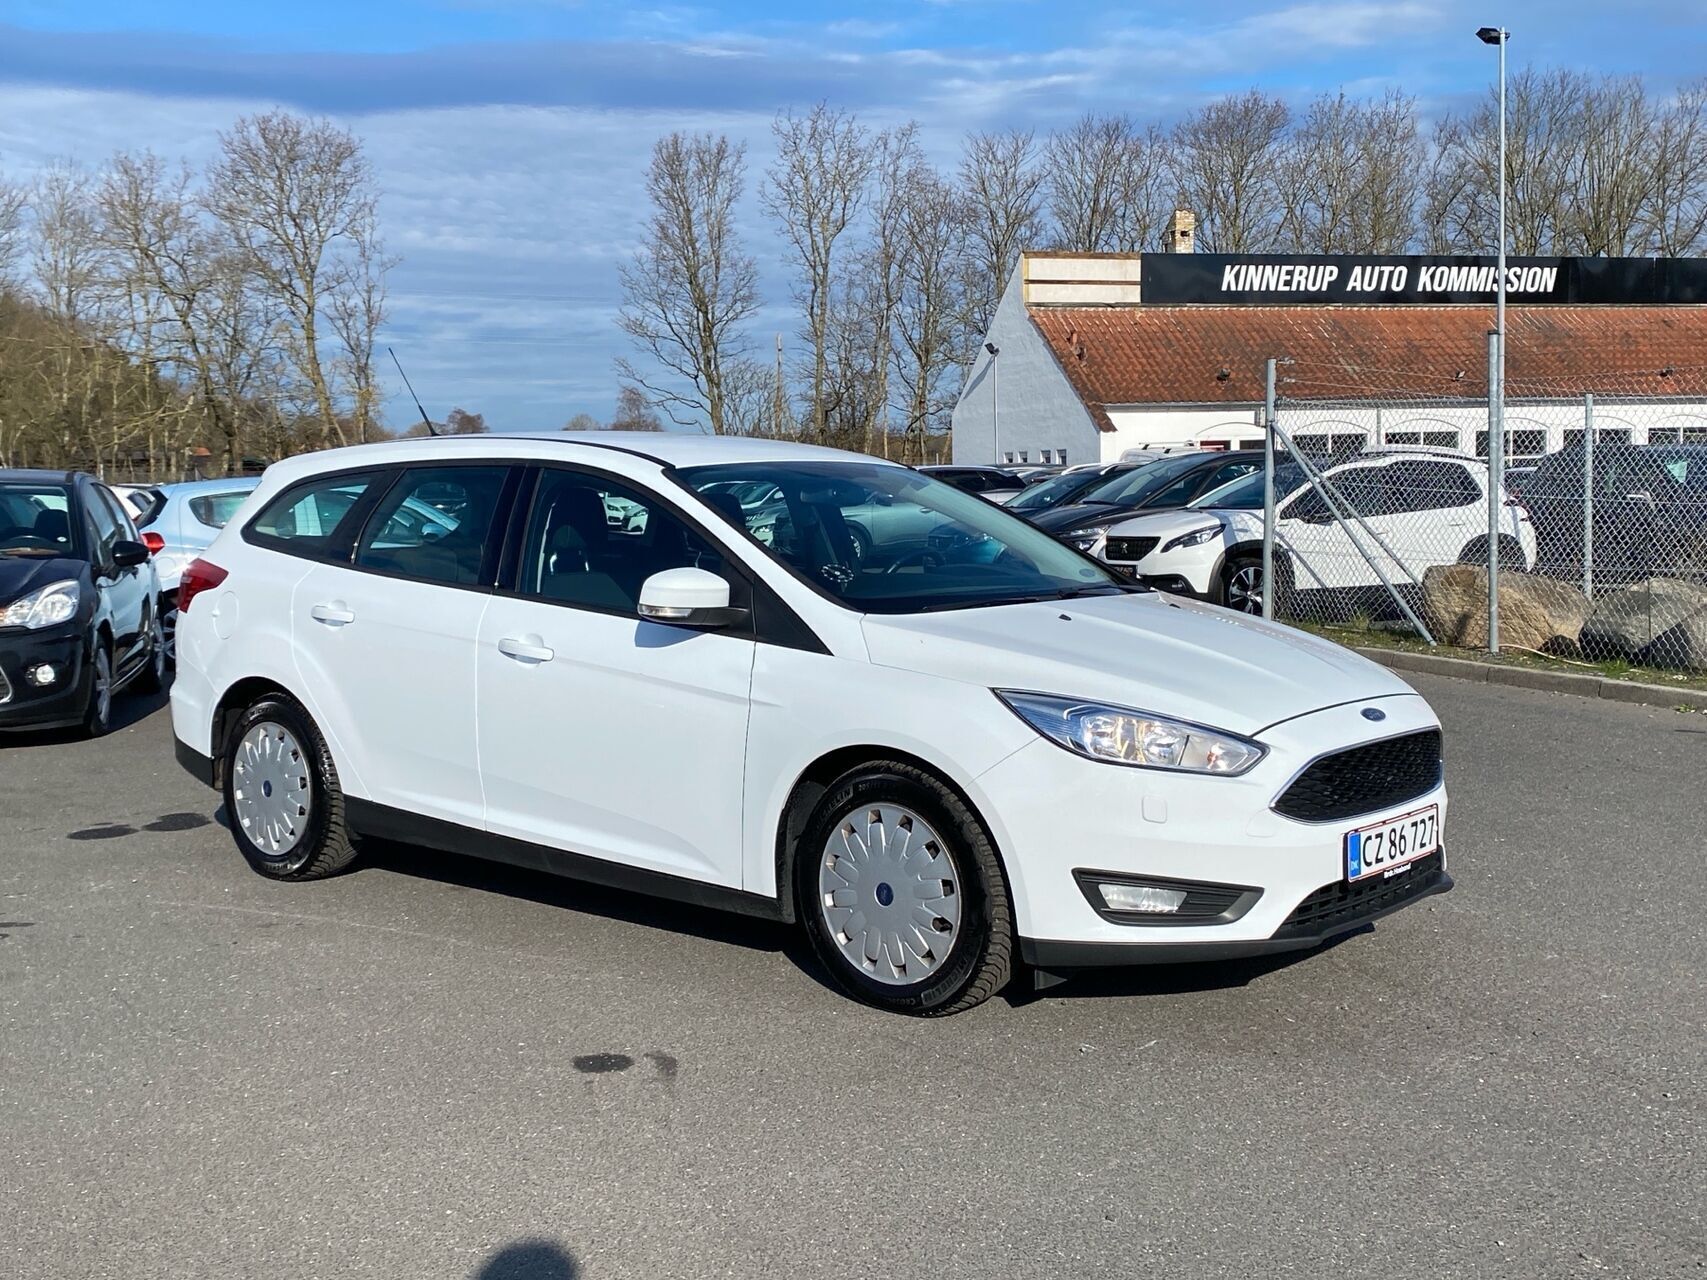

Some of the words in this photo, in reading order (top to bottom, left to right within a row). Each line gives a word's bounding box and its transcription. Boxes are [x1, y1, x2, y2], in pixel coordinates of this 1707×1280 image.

[1221, 265, 1339, 291] KINNERUP
[1346, 266, 1408, 292] AUTO
[1362, 832, 1384, 867] CZ
[1388, 824, 1407, 860] 86
[1411, 814, 1435, 852] 727
